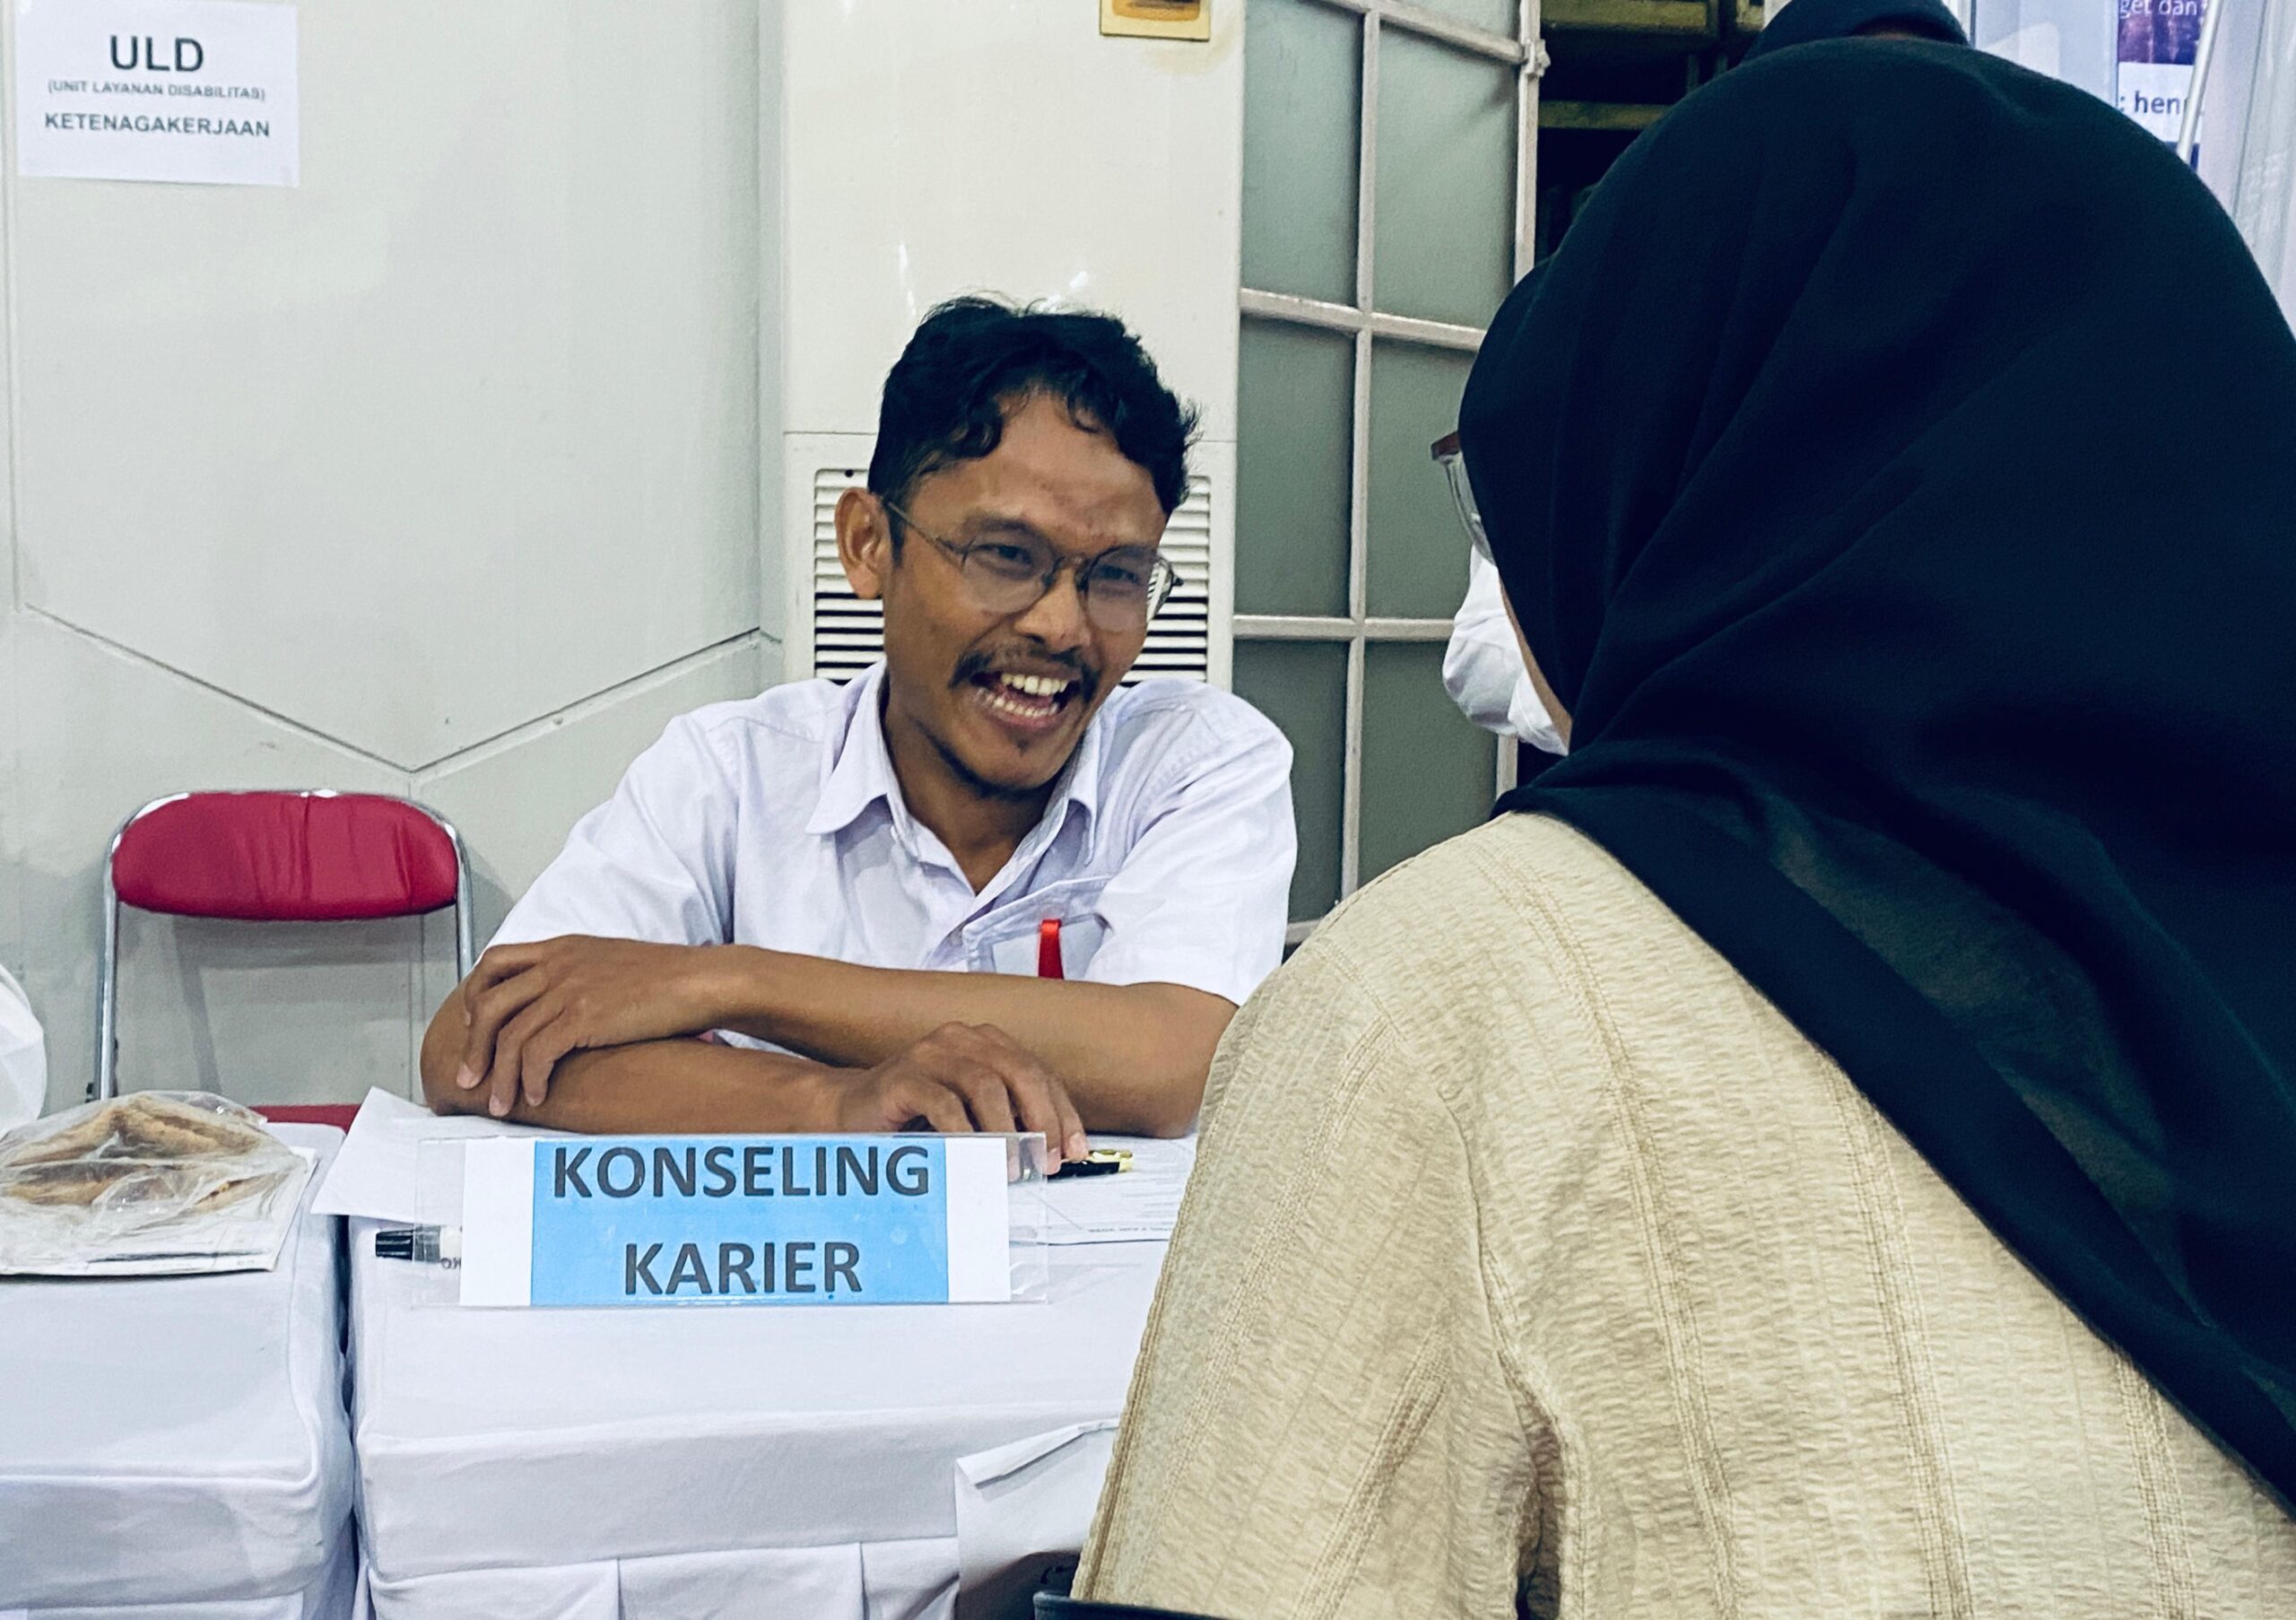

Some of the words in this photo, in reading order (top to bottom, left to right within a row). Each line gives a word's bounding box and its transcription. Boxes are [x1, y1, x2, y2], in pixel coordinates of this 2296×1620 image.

[109, 35, 204, 72] ULD
[48, 80, 88, 94] (UNIT
[92, 82, 163, 96] LAYANAN
[168, 85, 265, 100] DISABILITAS)
[46, 113, 270, 136] KETENAGAKERJAAN
[554, 1145, 929, 1198] KONSELING
[625, 1241, 863, 1295] KARIER
